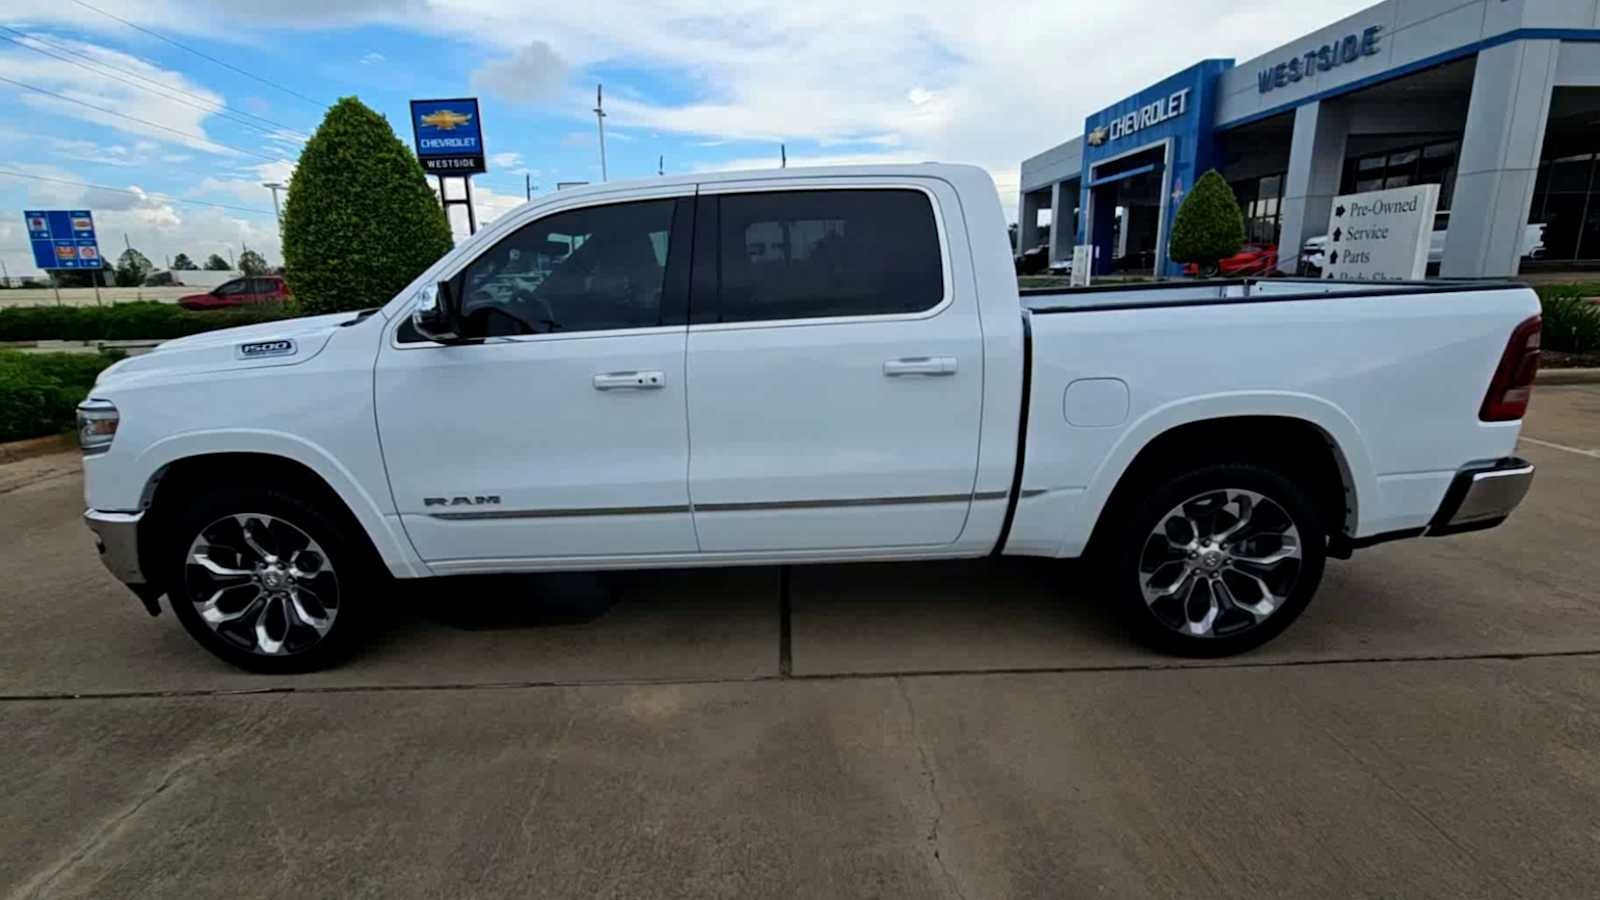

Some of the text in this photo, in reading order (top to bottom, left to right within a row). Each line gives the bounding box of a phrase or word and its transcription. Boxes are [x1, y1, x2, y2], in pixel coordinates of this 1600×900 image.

[1257, 24, 1383, 94] WESTSIDE
[1109, 86, 1192, 141] CHEVROLET
[420, 137, 476, 149] CHEVROLET
[426, 158, 476, 169] WESTSIDE
[1349, 195, 1418, 217] Pre-Owned
[1345, 224, 1389, 241] Service
[1342, 248, 1371, 264] Parts
[244, 341, 288, 353] 1500
[423, 495, 502, 507] RAM
